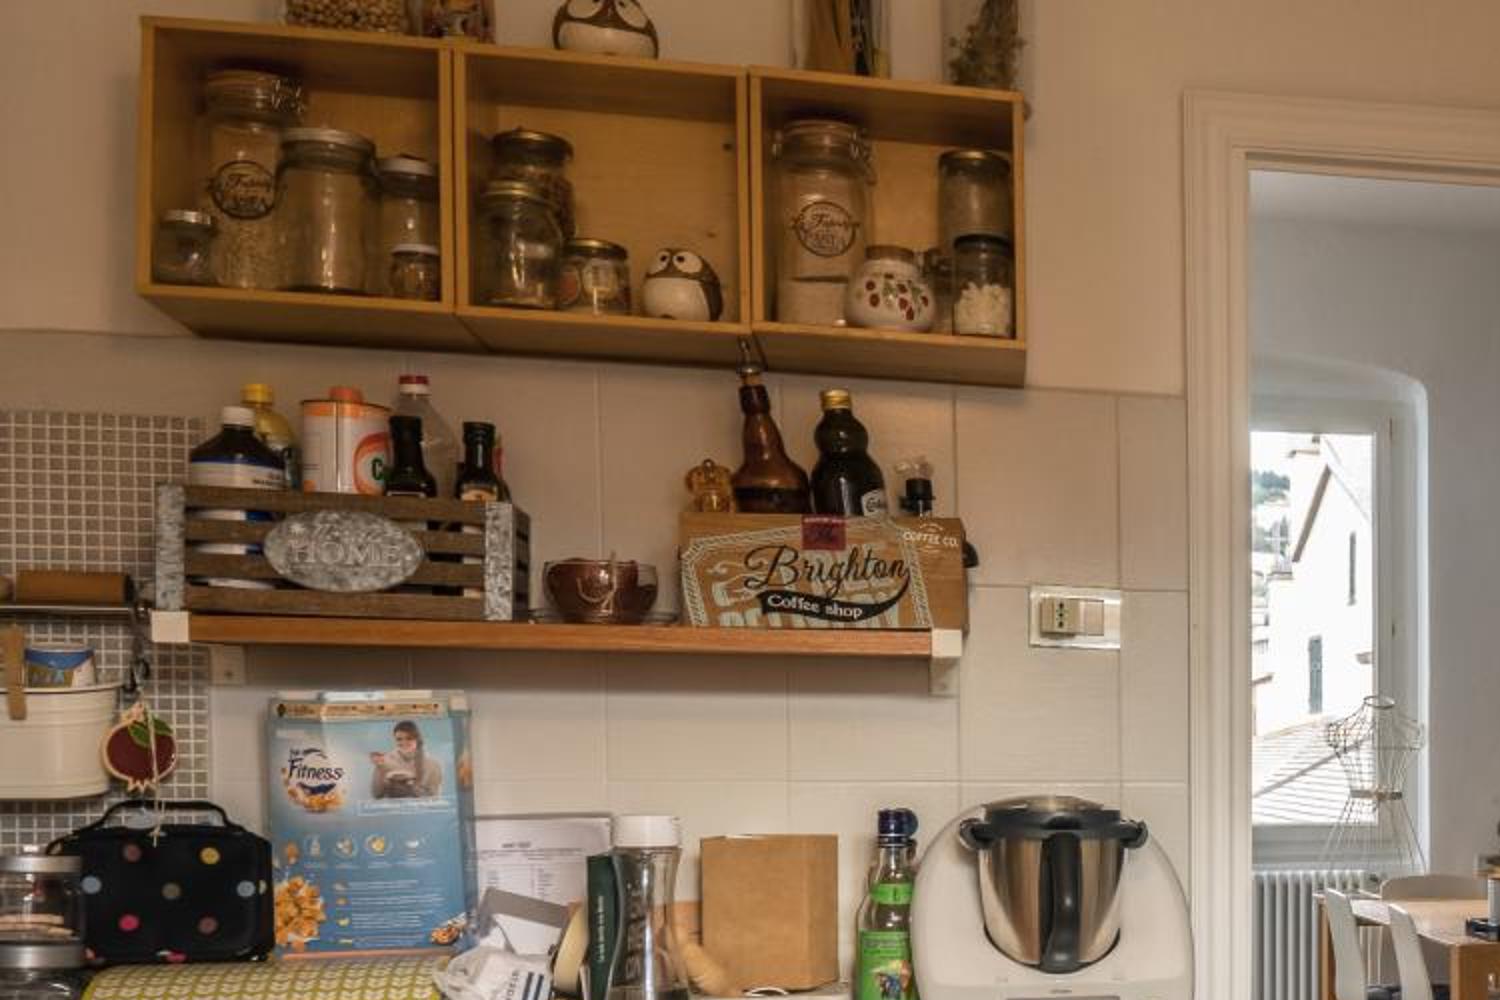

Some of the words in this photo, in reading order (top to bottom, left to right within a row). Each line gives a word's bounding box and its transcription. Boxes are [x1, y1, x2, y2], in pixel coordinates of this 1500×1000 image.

[288, 539, 401, 566] HOME
[743, 544, 911, 598] Brighton
[767, 593, 821, 615] Coffee
[825, 601, 863, 621] shop
[287, 756, 345, 781] Fitness
